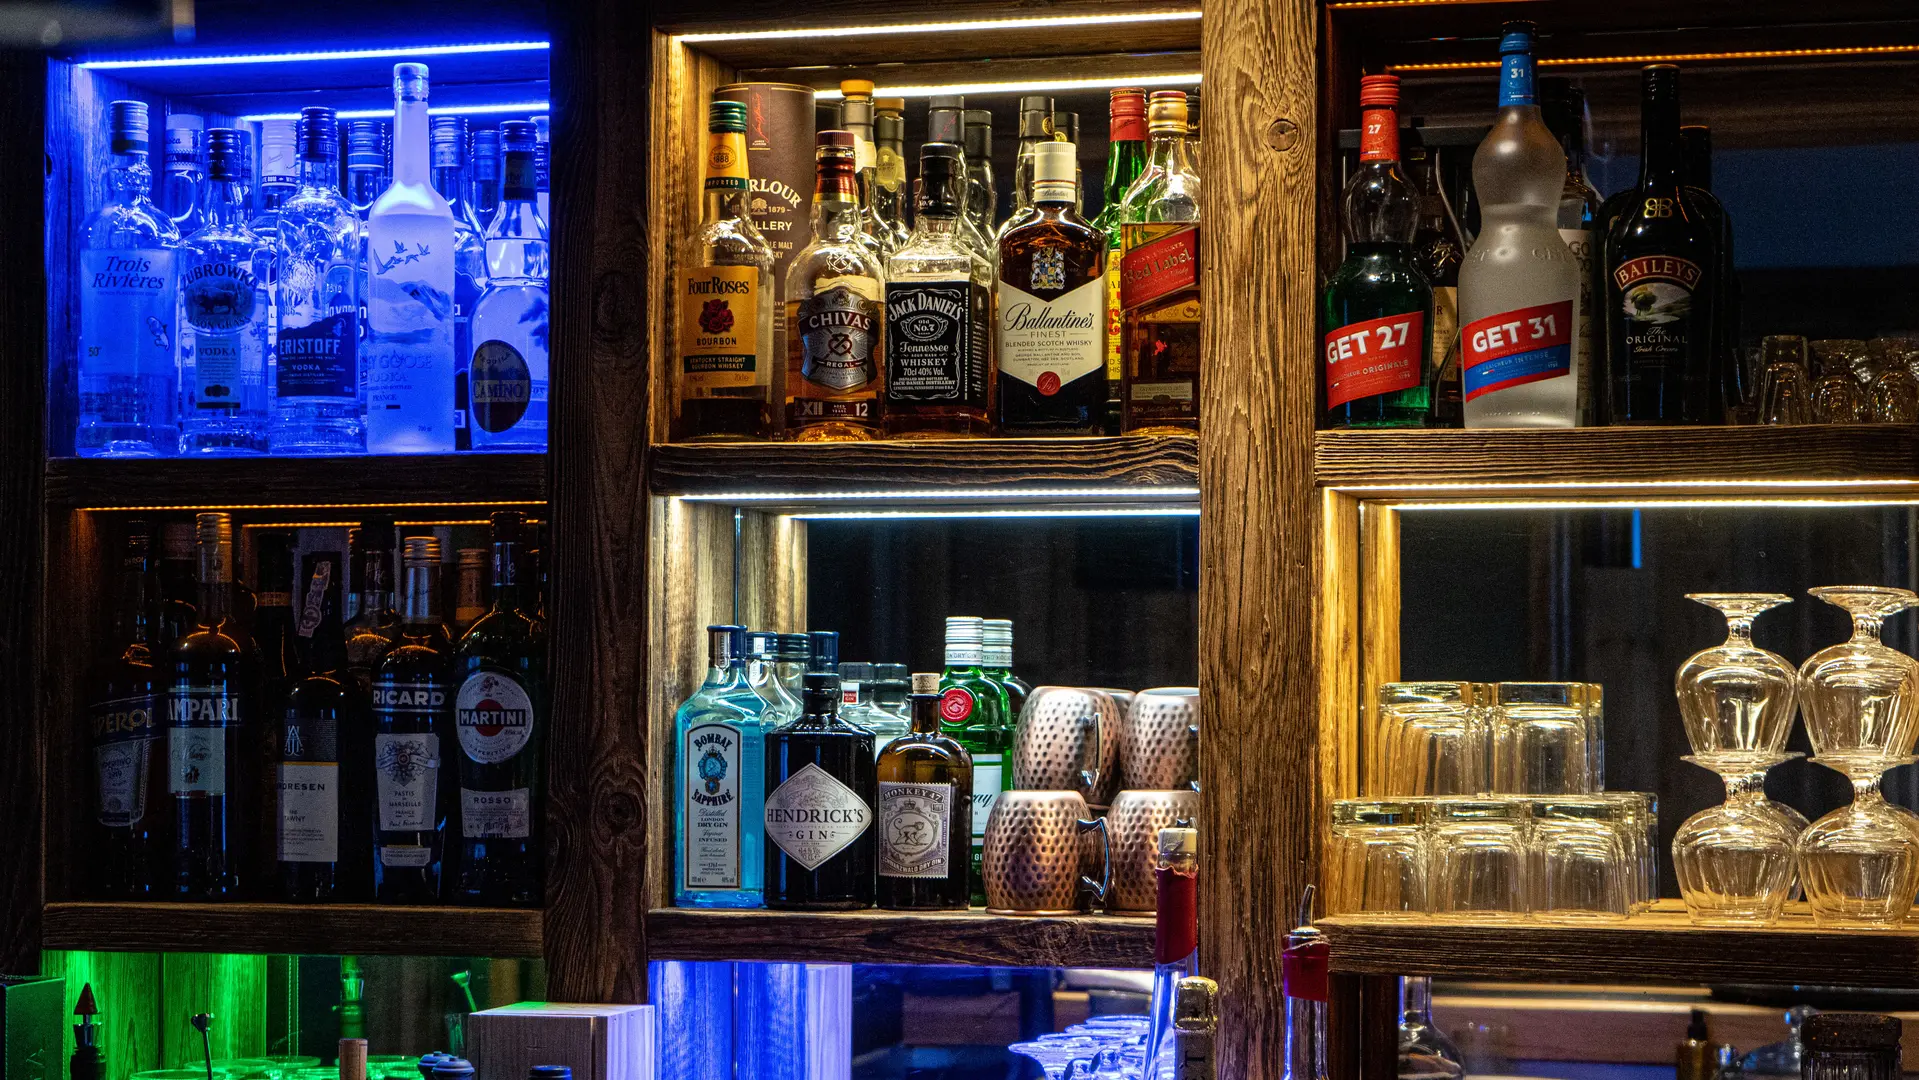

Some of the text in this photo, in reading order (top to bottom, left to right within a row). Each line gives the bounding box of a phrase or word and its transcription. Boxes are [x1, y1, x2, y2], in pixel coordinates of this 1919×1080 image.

[1510, 68, 1524, 79] 31
[1368, 124, 1382, 135] 27
[713, 154, 730, 163] 1888
[749, 178, 803, 209] RLOUR
[768, 206, 786, 214] 1879
[755, 220, 793, 231] LLERY
[105, 256, 151, 272] Trois
[1124, 247, 1192, 285] Red Label
[1618, 258, 1697, 284] BAILEYS
[92, 272, 165, 289] Rivières
[687, 276, 750, 295] Four Roses
[888, 292, 964, 322] JACK DANIEL'S
[809, 312, 872, 331] CHIVAS
[1003, 302, 1095, 332] Ballantine's
[913, 324, 935, 332] No.7
[1030, 330, 1067, 338] FINEST
[1472, 320, 1522, 353] GET
[1527, 314, 1557, 339] 31
[1646, 326, 1667, 336] The
[280, 338, 340, 355] ERISTOFF
[696, 337, 737, 346] BOURBON
[1327, 330, 1371, 364] GET
[1376, 321, 1411, 351] 27
[1625, 333, 1688, 345] ORIGINAL
[199, 347, 236, 356] VODKA
[900, 341, 949, 353] Tennessee
[900, 358, 948, 366] WHISKEY
[1514, 351, 1549, 364] INTENSE
[903, 367, 945, 376] 70cl 40% Vol.
[1362, 359, 1409, 375] ORIGINALE
[473, 382, 524, 399] CAMINO
[802, 401, 823, 416] XII
[855, 402, 868, 417] 12
[372, 690, 446, 706] RICARD
[168, 698, 239, 721] AMPARI
[92, 707, 157, 736] PEROL
[460, 711, 525, 725] MARTINI
[693, 733, 733, 752] BOMBAY
[691, 788, 735, 807] SAPPHIRE
[884, 788, 942, 801] MONKEY 47
[698, 808, 727, 817] Distilled
[767, 808, 864, 823] HENDRICK'S
[796, 830, 828, 840] GIN
[920, 862, 931, 870] DRY
[931, 858, 942, 866] GIN
